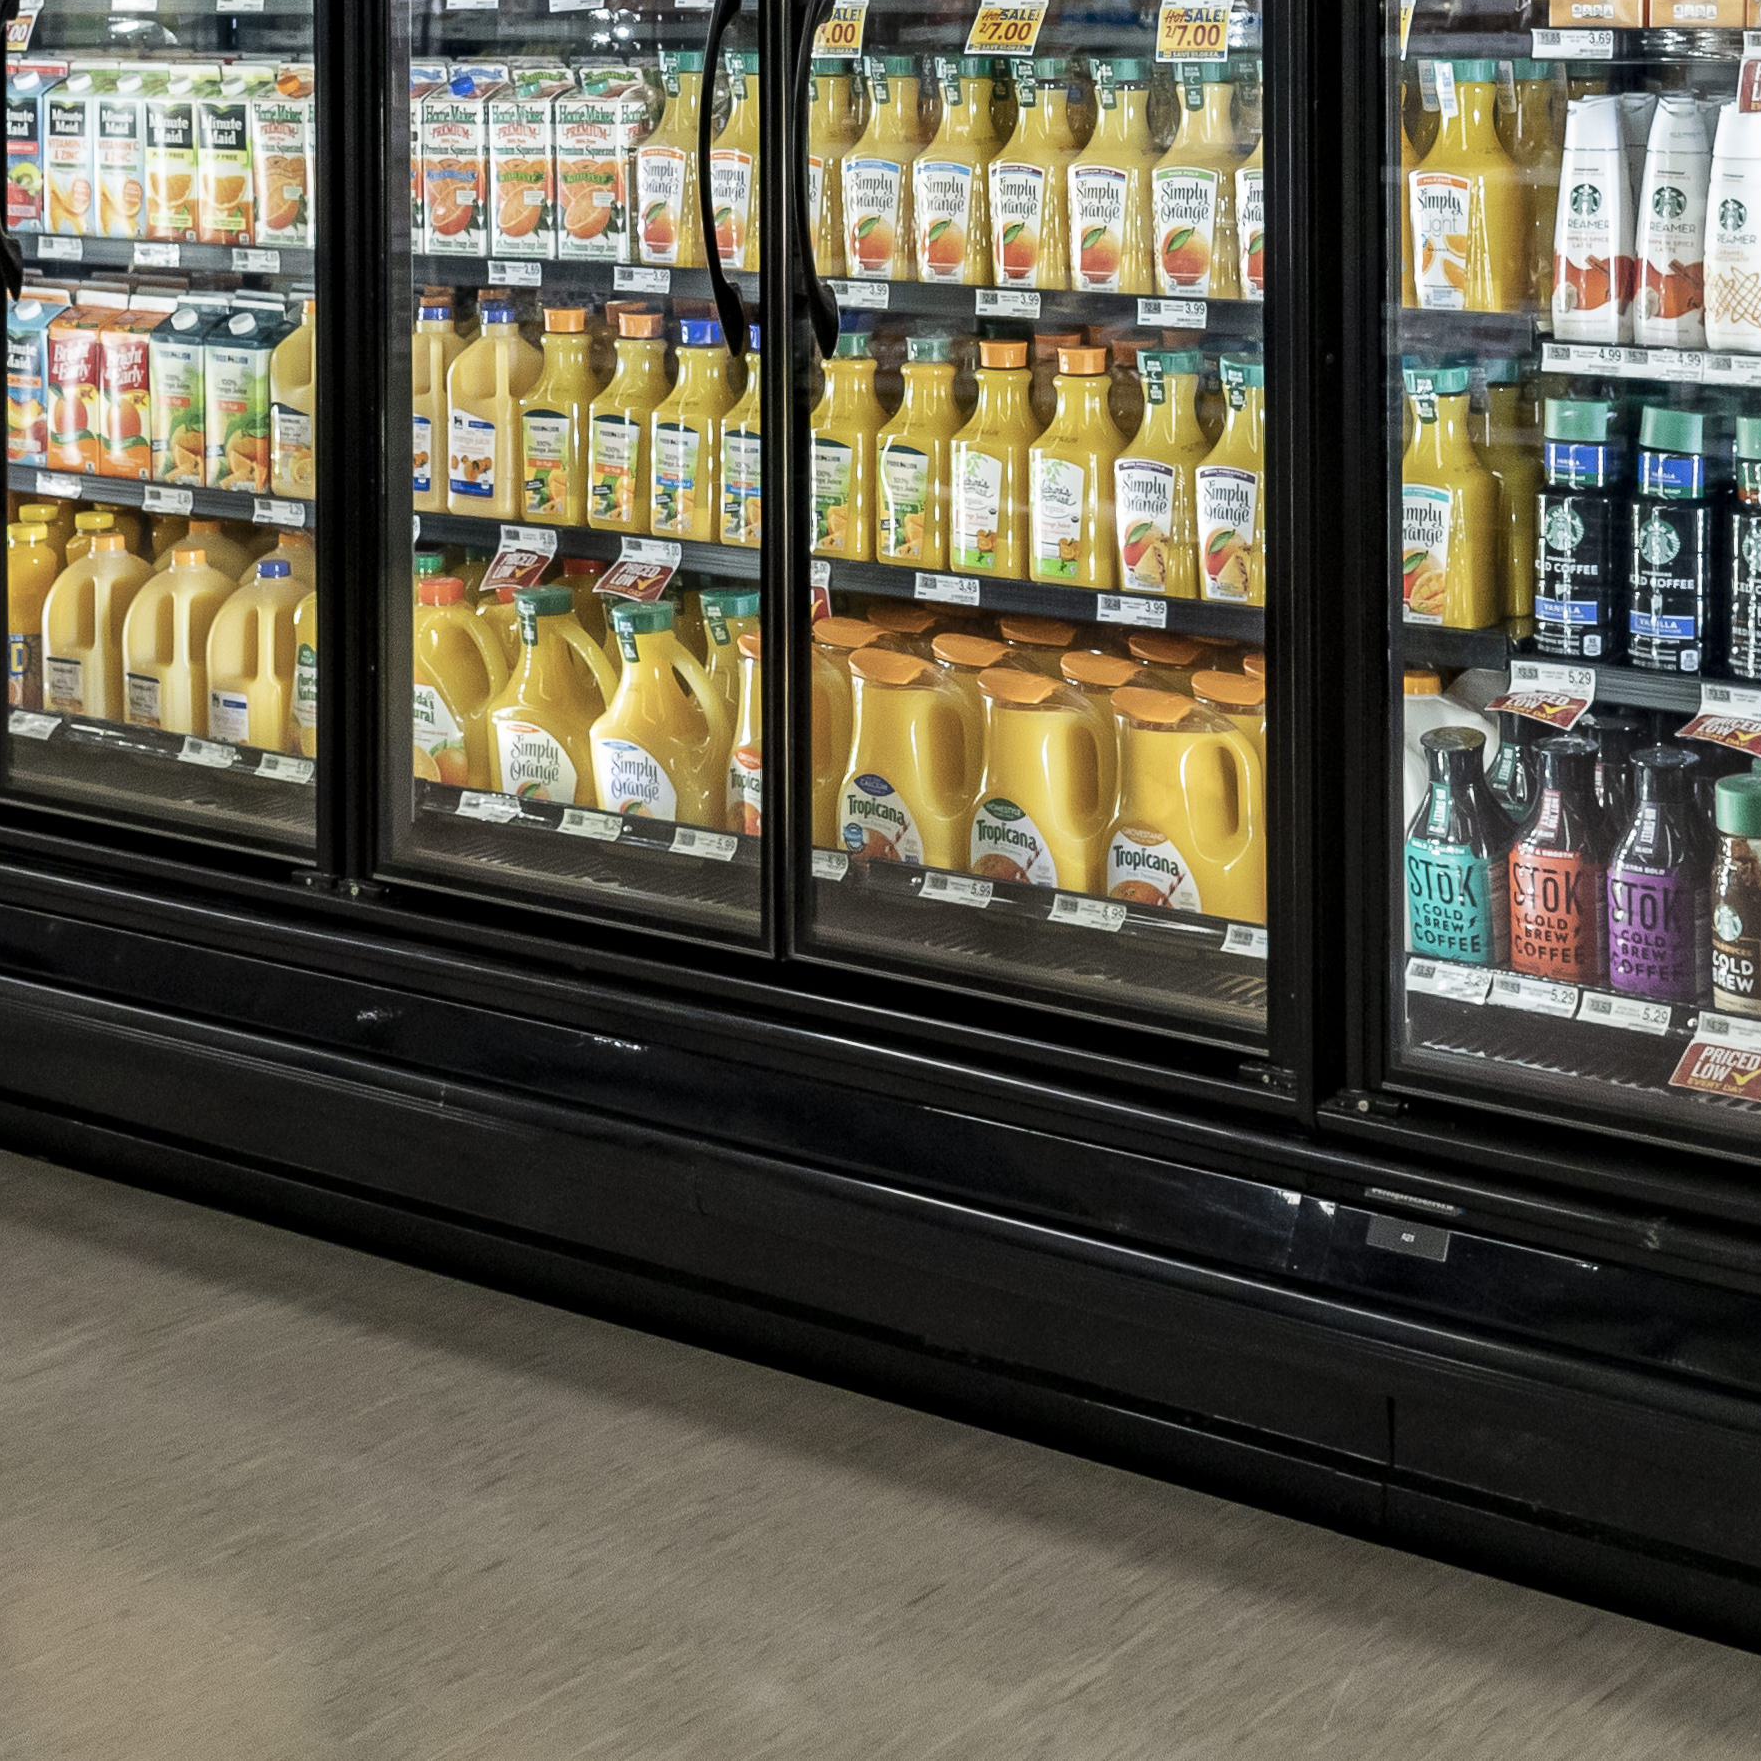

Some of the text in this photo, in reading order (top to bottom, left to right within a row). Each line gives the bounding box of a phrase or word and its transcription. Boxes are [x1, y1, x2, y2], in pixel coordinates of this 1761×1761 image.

[1588, 31, 1612, 45] 3.69
[148, 115, 190, 134] Minute
[1077, 180, 1120, 203] Simply
[1162, 181, 1208, 205] Simply
[1185, 303, 1206, 316] 3.99
[1598, 347, 1622, 362] 4.99
[1567, 669, 1592, 684] 5.29
[610, 753, 658, 784] Simply
[610, 776, 659, 803] Orange
[847, 795, 906, 827] Tropicana
[977, 819, 1037, 851] Tropicana
[1422, 902, 1464, 921] COLD
[1423, 915, 1465, 932] BREW
[1415, 922, 1481, 954] COFFEE
